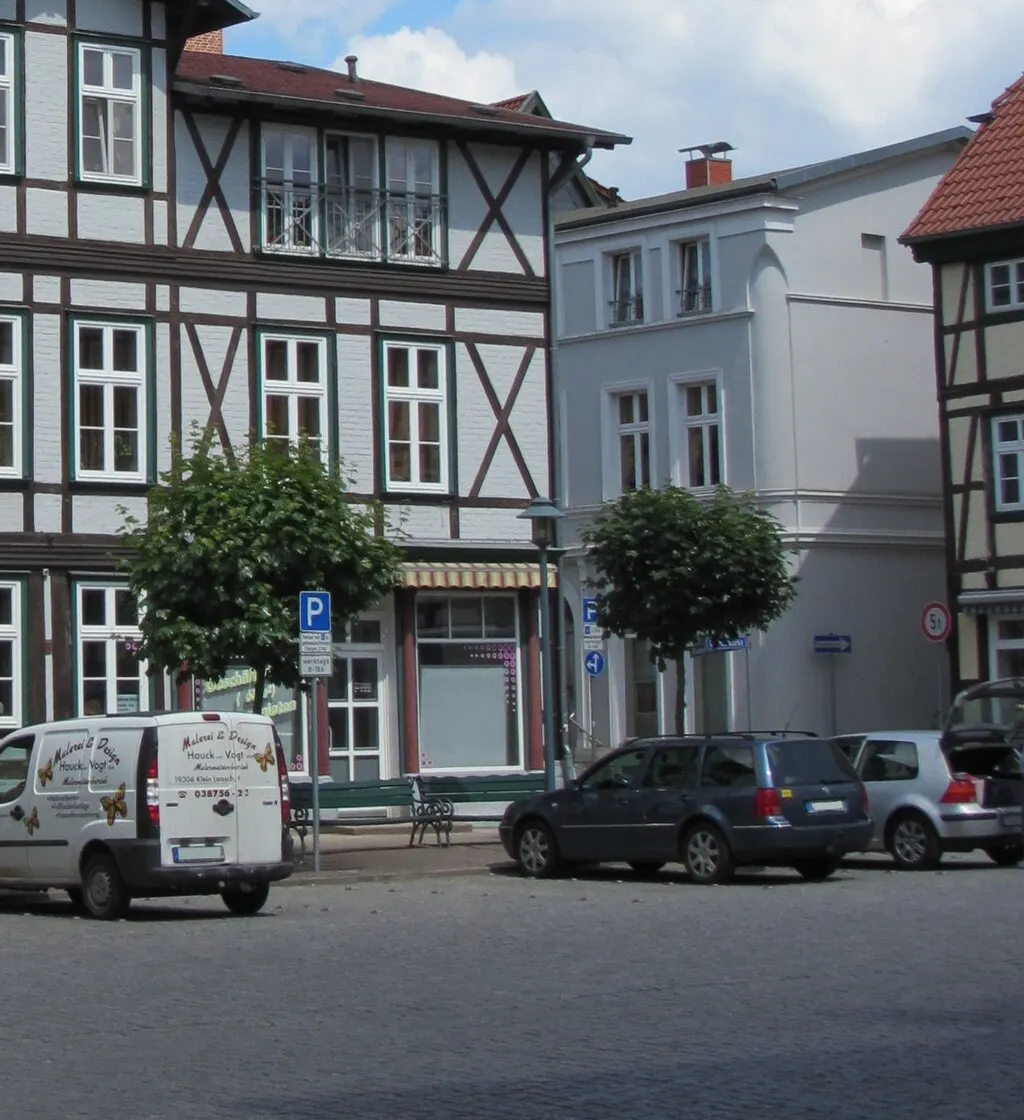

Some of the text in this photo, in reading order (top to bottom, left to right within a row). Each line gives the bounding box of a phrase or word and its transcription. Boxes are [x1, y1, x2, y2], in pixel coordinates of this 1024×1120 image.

[307, 597, 323, 626] P
[182, 732, 214, 751] Malerei
[229, 731, 256, 750] Design
[53, 739, 85, 766] Malerei
[97, 737, 120, 765] Design
[188, 750, 244, 761] Hauck Vogt
[89, 760, 106, 773] Vogt
[195, 789, 230, 798] 038756
